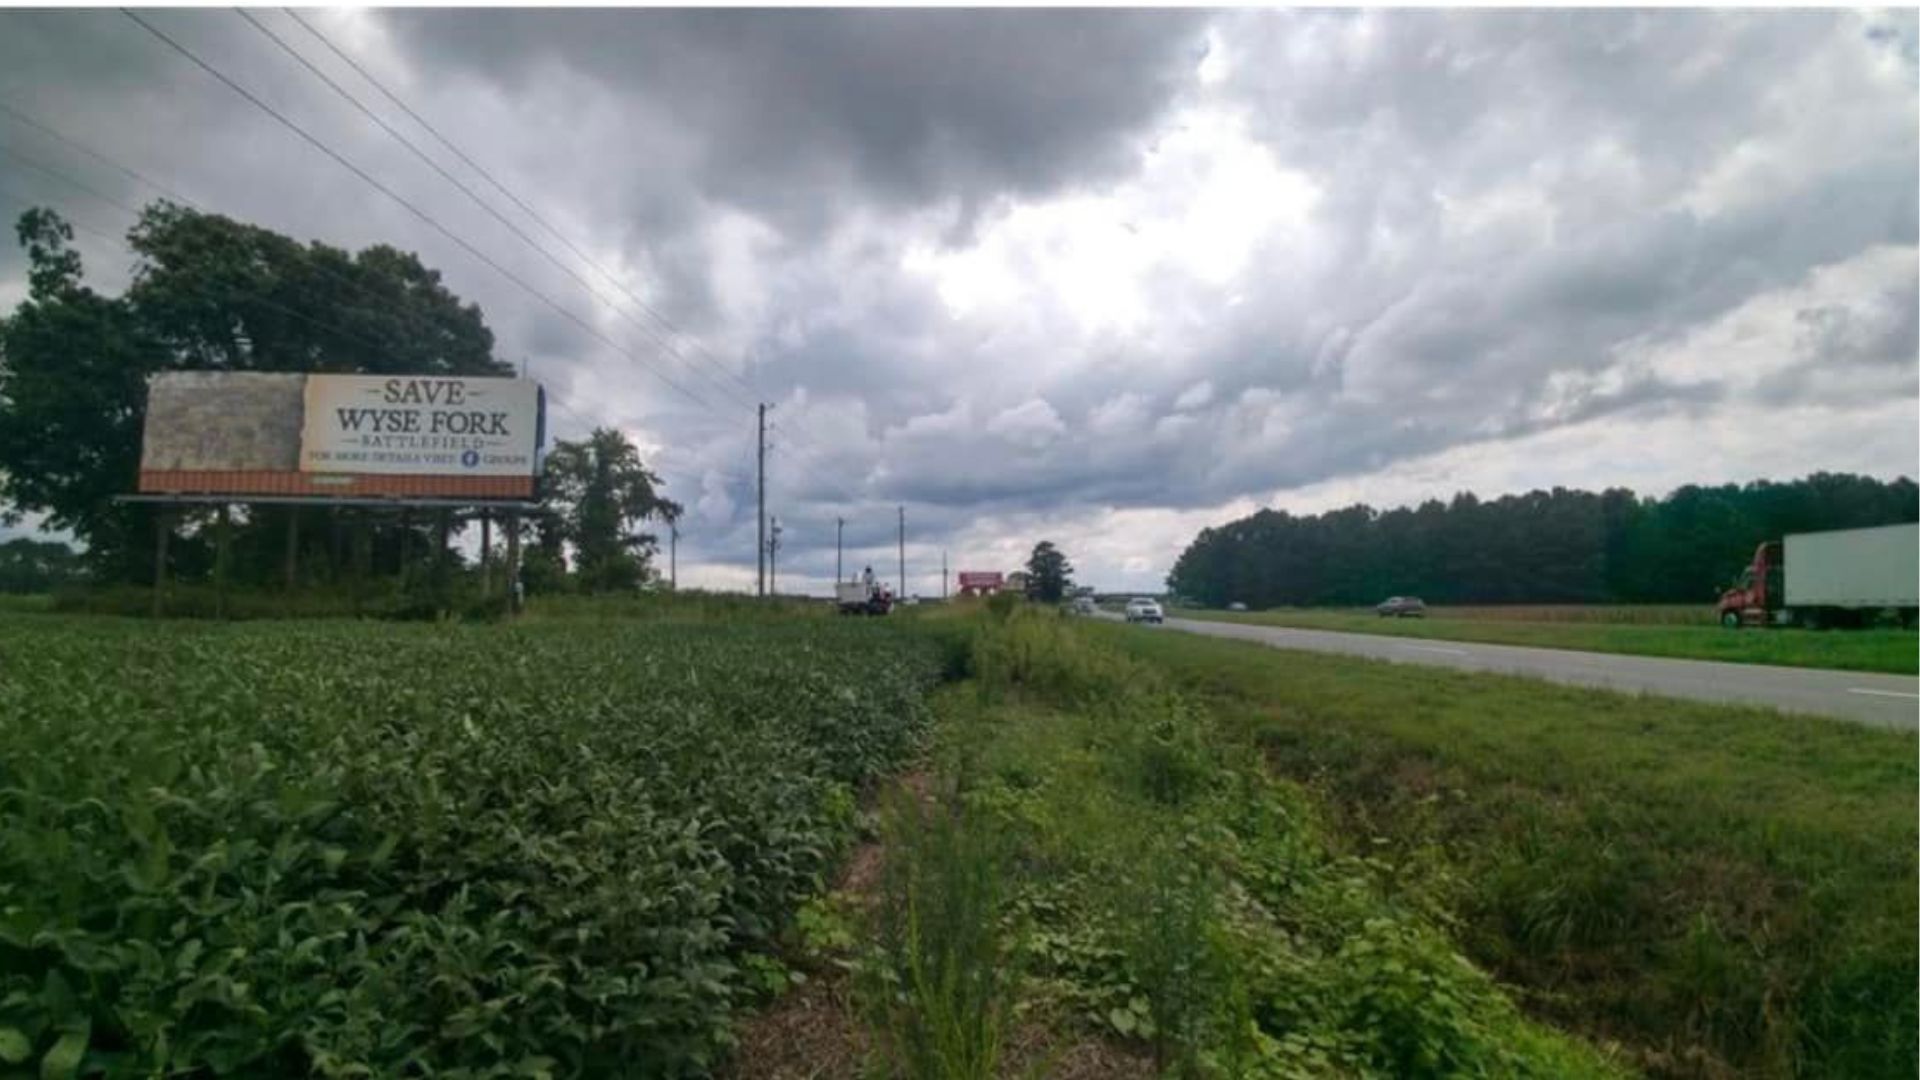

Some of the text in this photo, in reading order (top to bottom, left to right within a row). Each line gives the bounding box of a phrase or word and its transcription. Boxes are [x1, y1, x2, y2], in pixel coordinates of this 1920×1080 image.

[384, 379, 465, 405] SAVE
[337, 408, 510, 435] WYSE FORK
[361, 434, 484, 450] BATTLEFIELD
